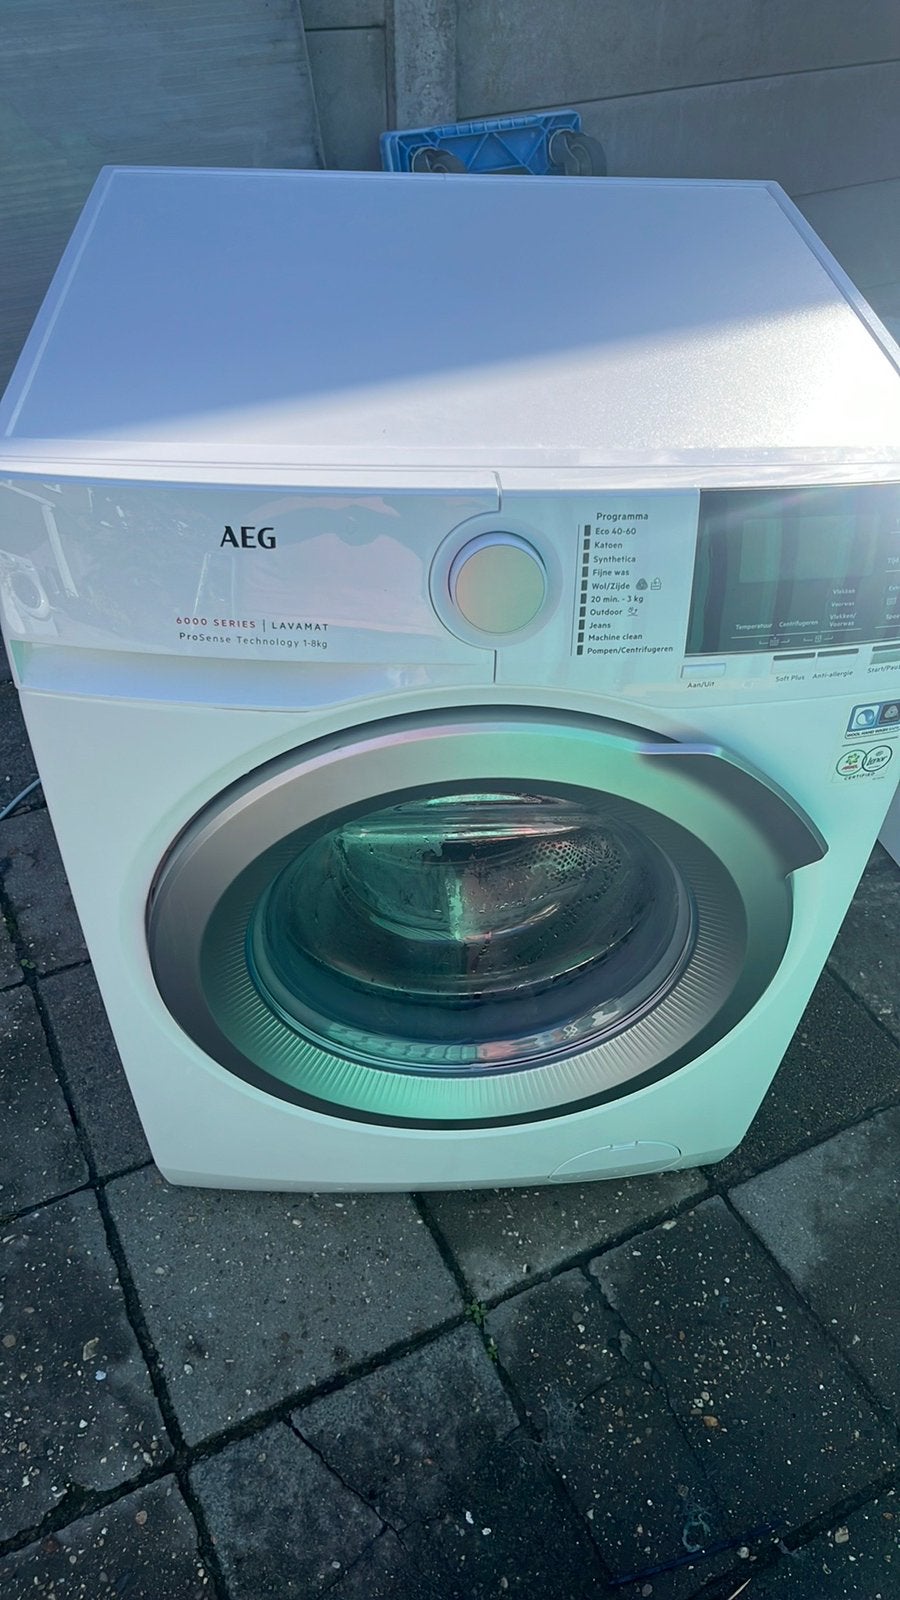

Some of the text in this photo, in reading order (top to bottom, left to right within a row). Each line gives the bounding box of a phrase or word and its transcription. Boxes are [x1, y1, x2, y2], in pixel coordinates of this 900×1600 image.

[596, 512, 649, 522] Programma
[595, 527, 637, 535] Eco 40-60
[220, 525, 276, 549] AEG
[594, 541, 623, 549] Katoen
[593, 555, 636, 564] Synthetica
[592, 569, 630, 578] Fijne was
[592, 582, 631, 592] Wol/Zijde
[602, 595, 620, 603] min.
[627, 595, 632, 603] 3
[633, 595, 644, 604] kg
[589, 607, 623, 616] Outdoor
[176, 616, 329, 632] 6000 SERIES LAVAMAT
[588, 621, 611, 630] Jeans
[735, 619, 819, 631] Temperatuur Centrifugeren
[179, 632, 328, 649] ProSense Technology 1-8kg
[588, 632, 643, 642] Machine clean
[587, 645, 674, 655] Pompen/Centrifugeren
[790, 674, 805, 682] Plus
[812, 670, 853, 680] Anti-allergie
[687, 680, 715, 689] Aan/Uit
